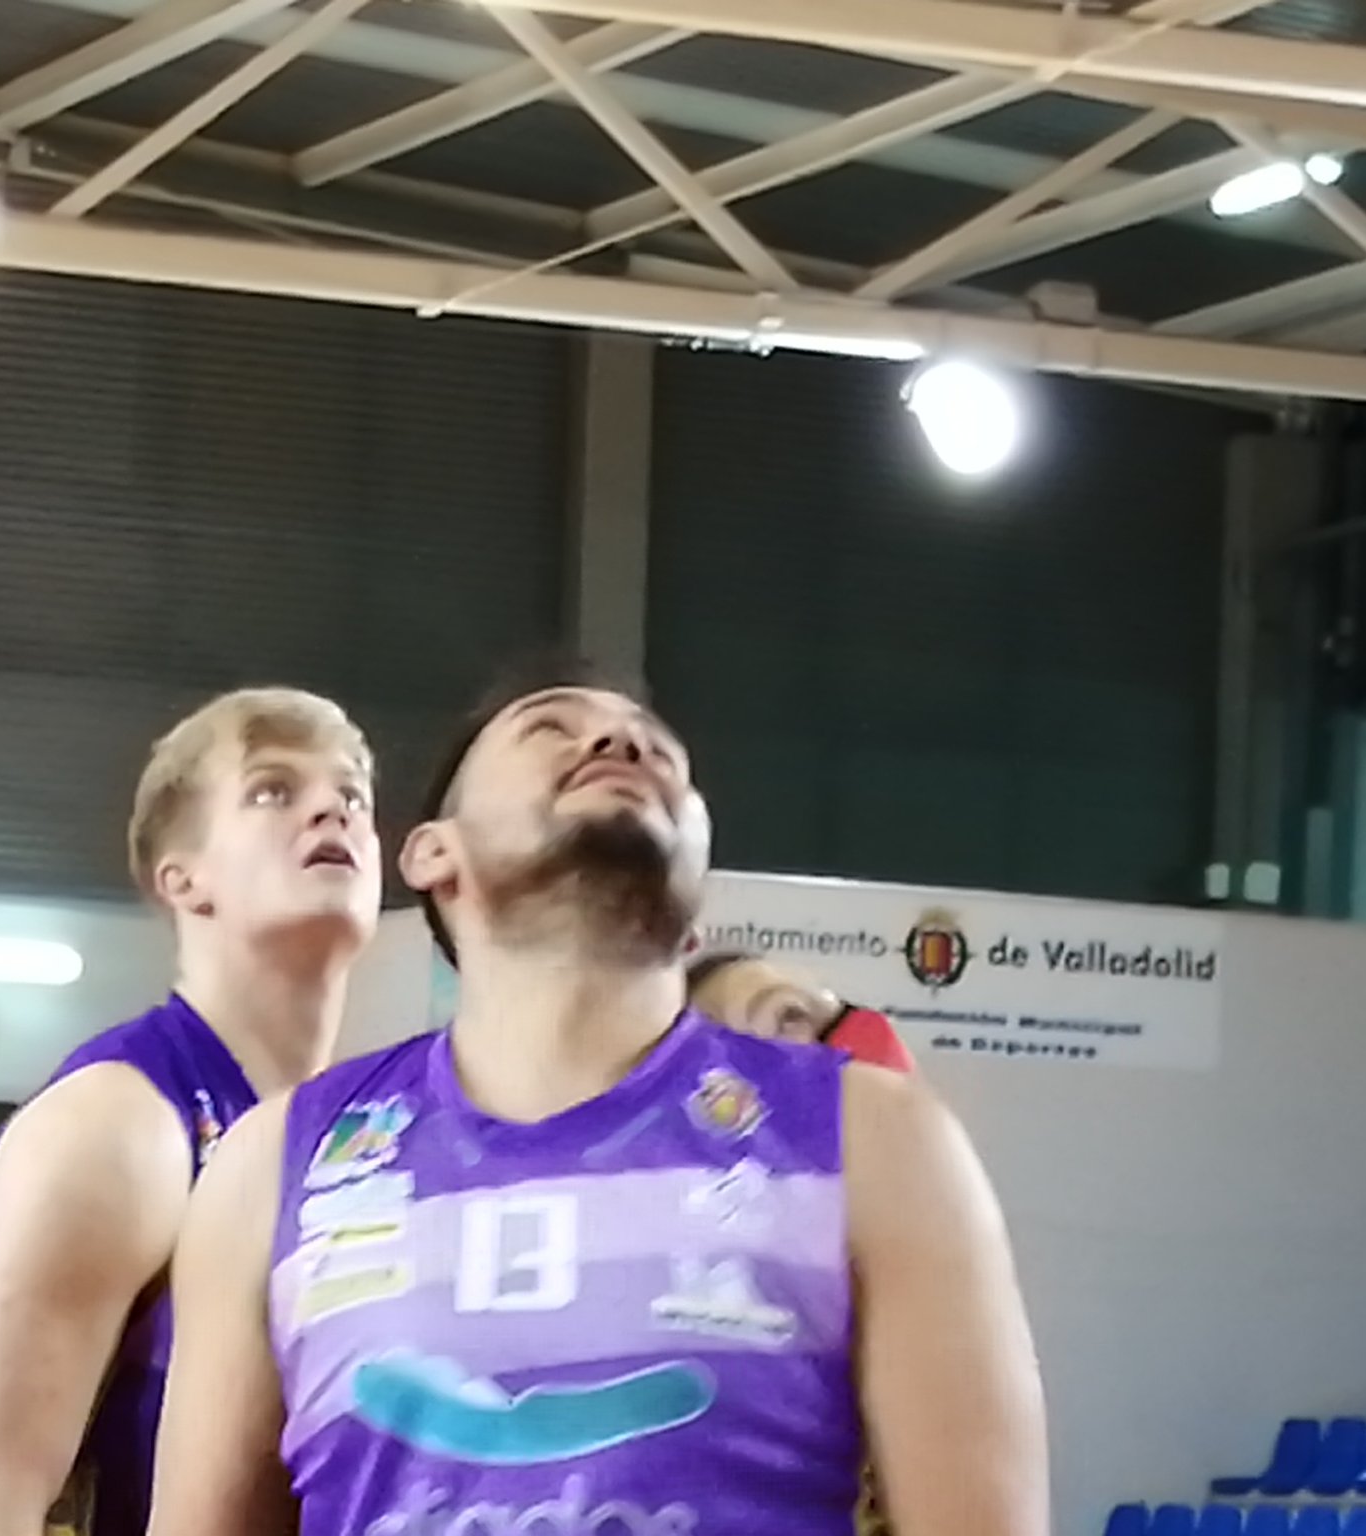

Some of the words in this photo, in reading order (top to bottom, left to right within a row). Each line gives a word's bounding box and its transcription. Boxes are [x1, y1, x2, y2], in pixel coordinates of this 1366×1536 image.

[706, 922, 887, 957] untamiento
[987, 936, 1028, 967] de
[1041, 940, 1217, 981] Valladolid
